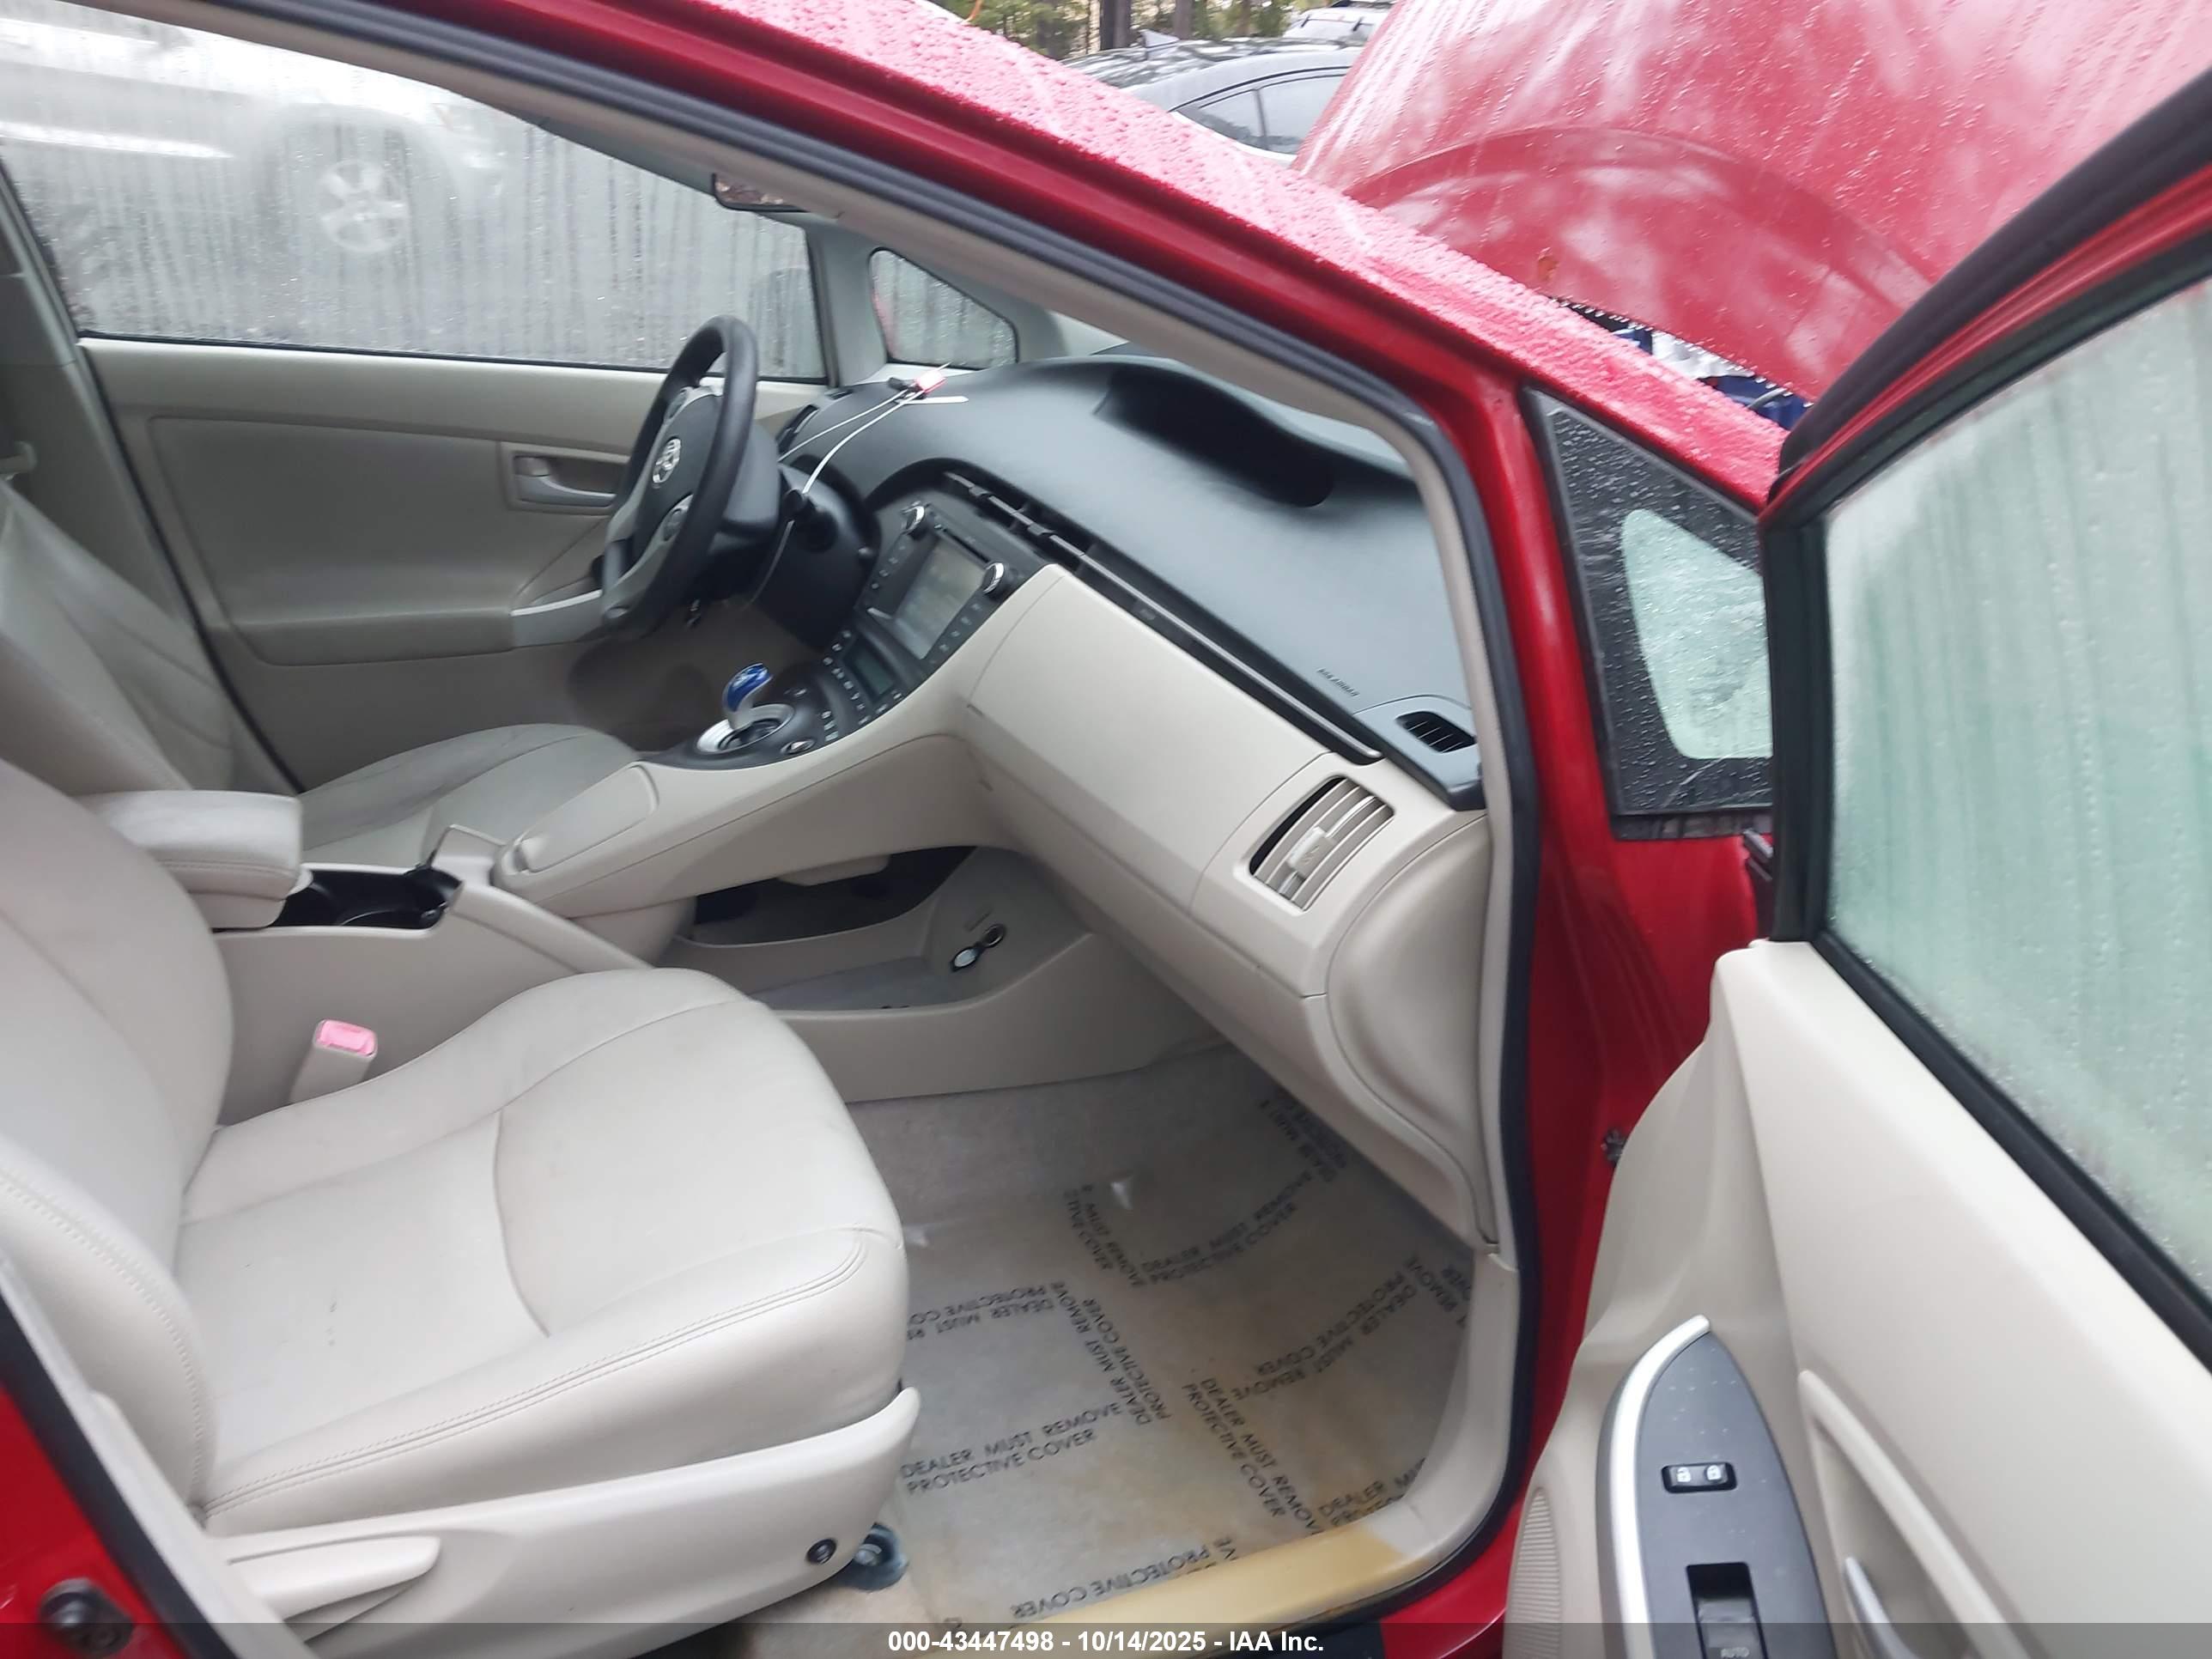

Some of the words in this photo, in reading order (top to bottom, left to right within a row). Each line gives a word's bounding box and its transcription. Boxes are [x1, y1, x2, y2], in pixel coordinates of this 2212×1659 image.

[1244, 1202, 1296, 1248] COVER
[938, 1313, 981, 1334] MUST
[944, 1285, 1046, 1317] PROTECTIVE
[991, 1298, 1054, 1320] DEALER
[1051, 1282, 1092, 1334] REMOVE
[1083, 1297, 1120, 1344] COVER
[1316, 1270, 1406, 1349] PROTECTIVE
[1360, 1284, 1417, 1335] DEALER
[1085, 1340, 1116, 1372] MUST
[1256, 1345, 1316, 1376] COVER
[1314, 1335, 1353, 1373] MUST
[1110, 1376, 1152, 1425] DEALER
[1112, 1346, 1172, 1419] PROTECTIVE
[1230, 1368, 1306, 1401] REMOVE
[901, 1449, 974, 1480] DEALER
[984, 1431, 1033, 1458] MUST
[1042, 1402, 1121, 1438] REMOVE
[1200, 1376, 1246, 1427] DEALER
[1242, 1433, 1279, 1468] MUST
[906, 1451, 1025, 1495] PROTECTIVE
[1028, 1427, 1097, 1462] COVER
[1182, 1383, 1247, 1461] PROTECTIVE
[1240, 1462, 1286, 1518] COVER
[1317, 1480, 1385, 1517] DEALER
[1091, 1545, 1210, 1597] PROTECTIVE
[1011, 1585, 1087, 1619] COVER
